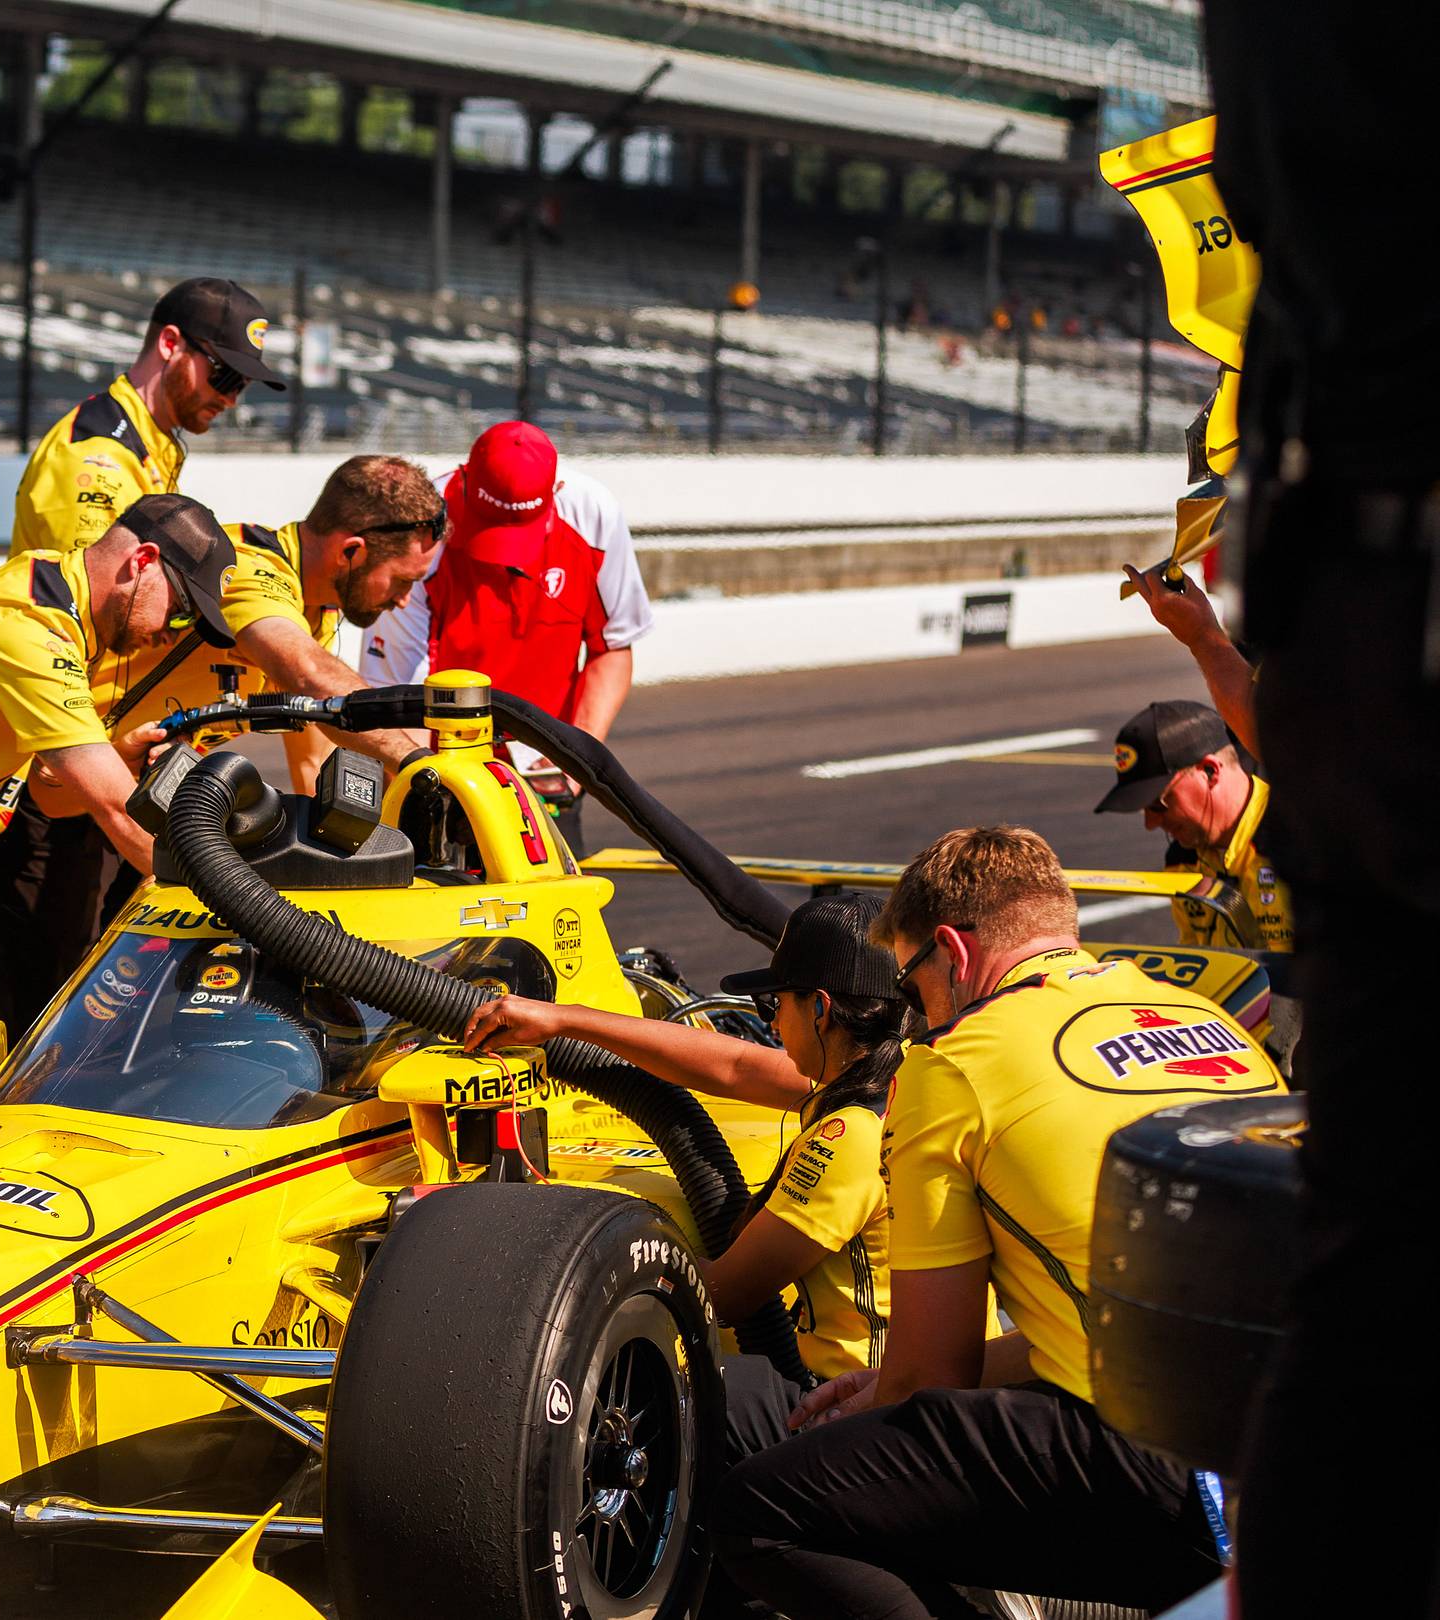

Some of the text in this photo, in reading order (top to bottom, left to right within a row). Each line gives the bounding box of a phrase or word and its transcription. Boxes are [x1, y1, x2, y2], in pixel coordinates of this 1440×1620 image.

[77, 492, 115, 505] DEX
[478, 487, 543, 510] Firestone
[483, 761, 548, 866] 3
[566, 920, 579, 932] NTT
[554, 938, 581, 951] INDYCAR
[206, 971, 235, 982] PENNZOIL
[209, 995, 237, 1005] NTT
[1093, 1021, 1250, 1079] PENNZOIL
[445, 1062, 546, 1104] Mazak
[806, 1139, 836, 1161] XPEL
[780, 1182, 810, 1206] SIEMENS
[629, 1238, 714, 1326] Firestone
